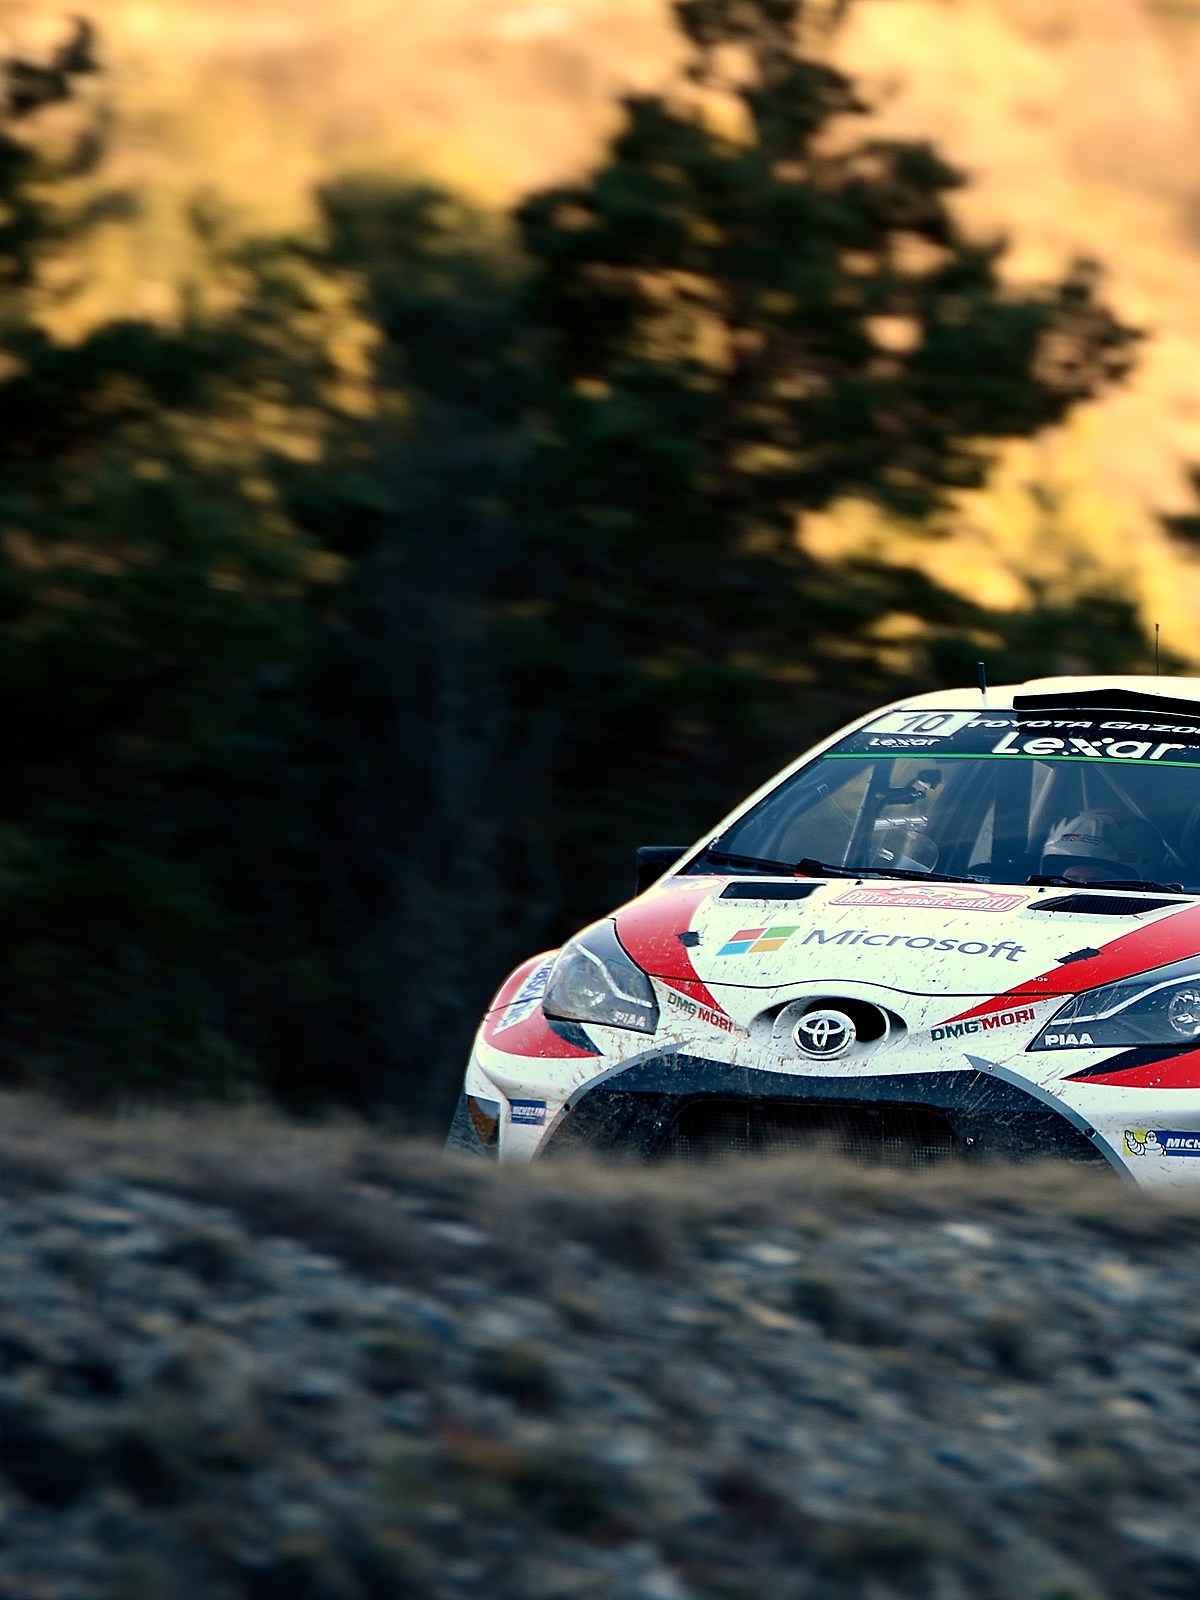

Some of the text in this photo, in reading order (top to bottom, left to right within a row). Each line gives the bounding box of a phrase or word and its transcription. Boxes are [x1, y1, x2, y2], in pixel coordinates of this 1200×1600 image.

[897, 713, 954, 733] 10
[967, 719, 1093, 729] TOYOTA
[869, 737, 941, 748] Lexar
[991, 731, 1187, 760] Lexar
[802, 929, 1028, 962] Microsoft
[667, 991, 734, 1034] DMG MORI
[930, 1007, 1036, 1042] DMG MORI
[1044, 1033, 1094, 1047] PIAA
